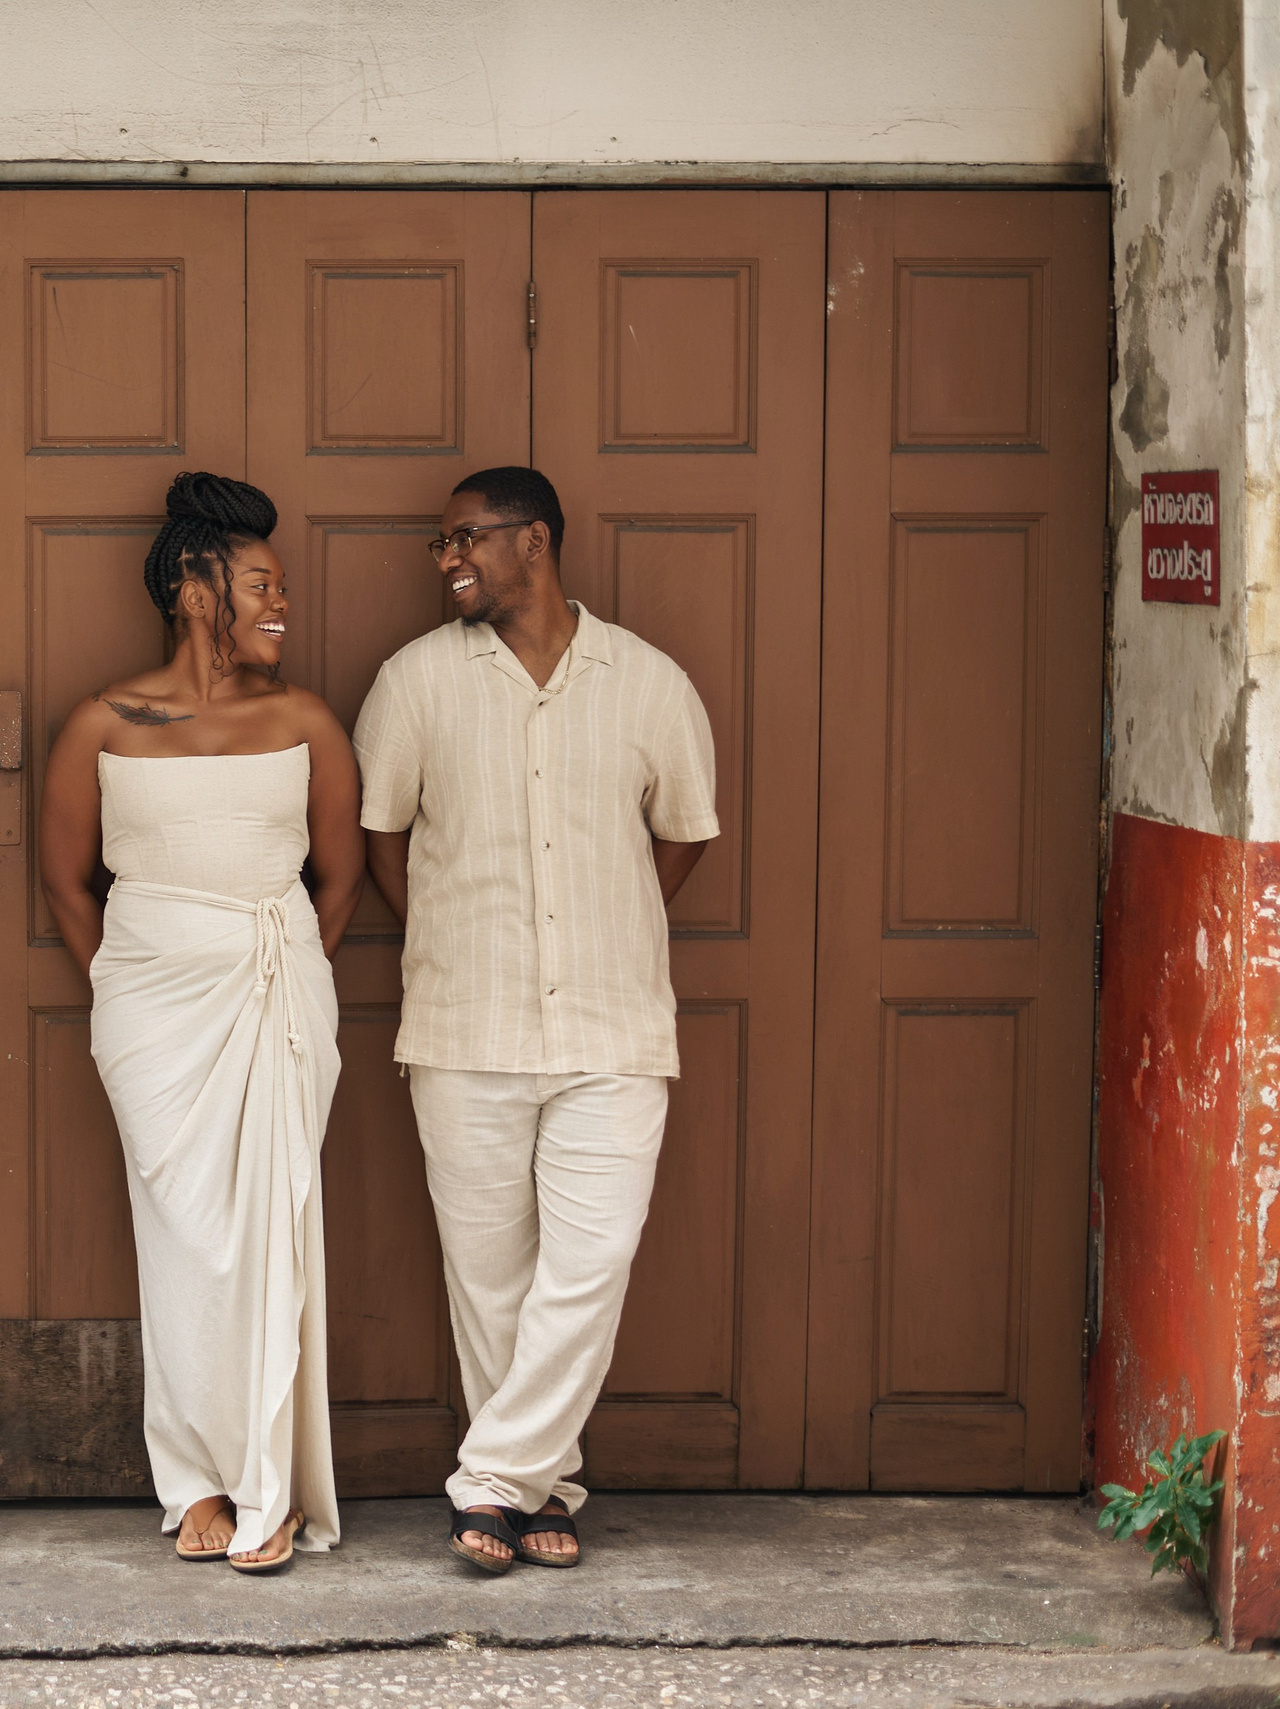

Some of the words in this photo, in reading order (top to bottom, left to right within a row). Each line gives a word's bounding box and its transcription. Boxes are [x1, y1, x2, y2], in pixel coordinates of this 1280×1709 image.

[1144, 482, 1214, 525] ห้ามจอดรถ
[1147, 540, 1212, 597] ขวางประตู
